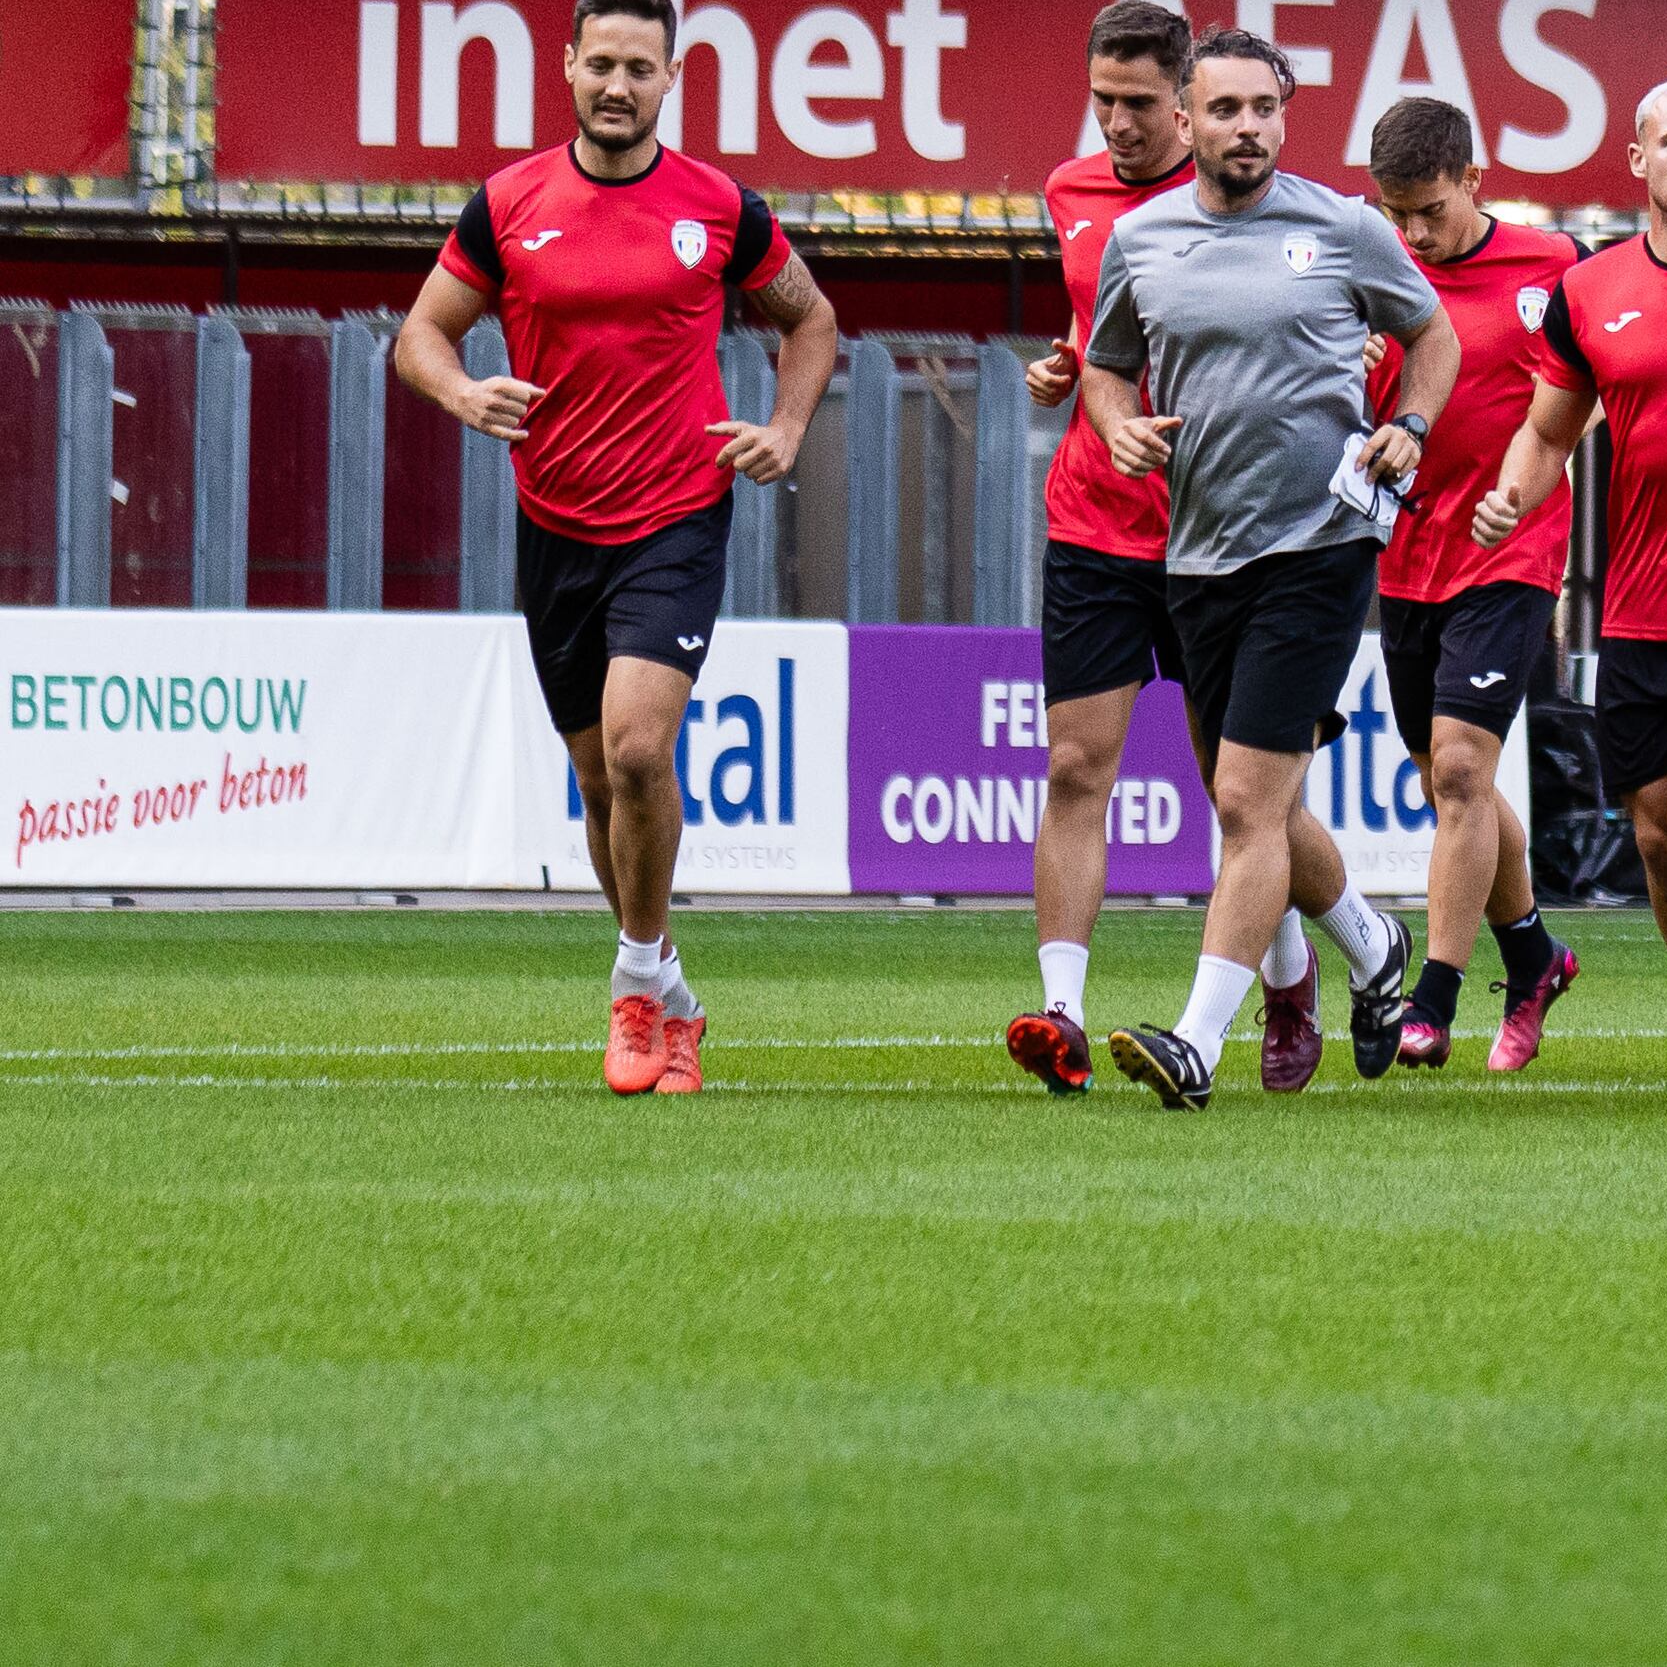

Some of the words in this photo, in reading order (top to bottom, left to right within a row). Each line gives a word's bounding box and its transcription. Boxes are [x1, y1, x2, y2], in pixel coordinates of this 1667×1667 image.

[11, 674, 307, 733] BETONBOUW
[16, 777, 121, 868] passie
[133, 779, 207, 829] voor
[219, 751, 308, 814] beton
[881, 775, 1183, 844] CONNTED
